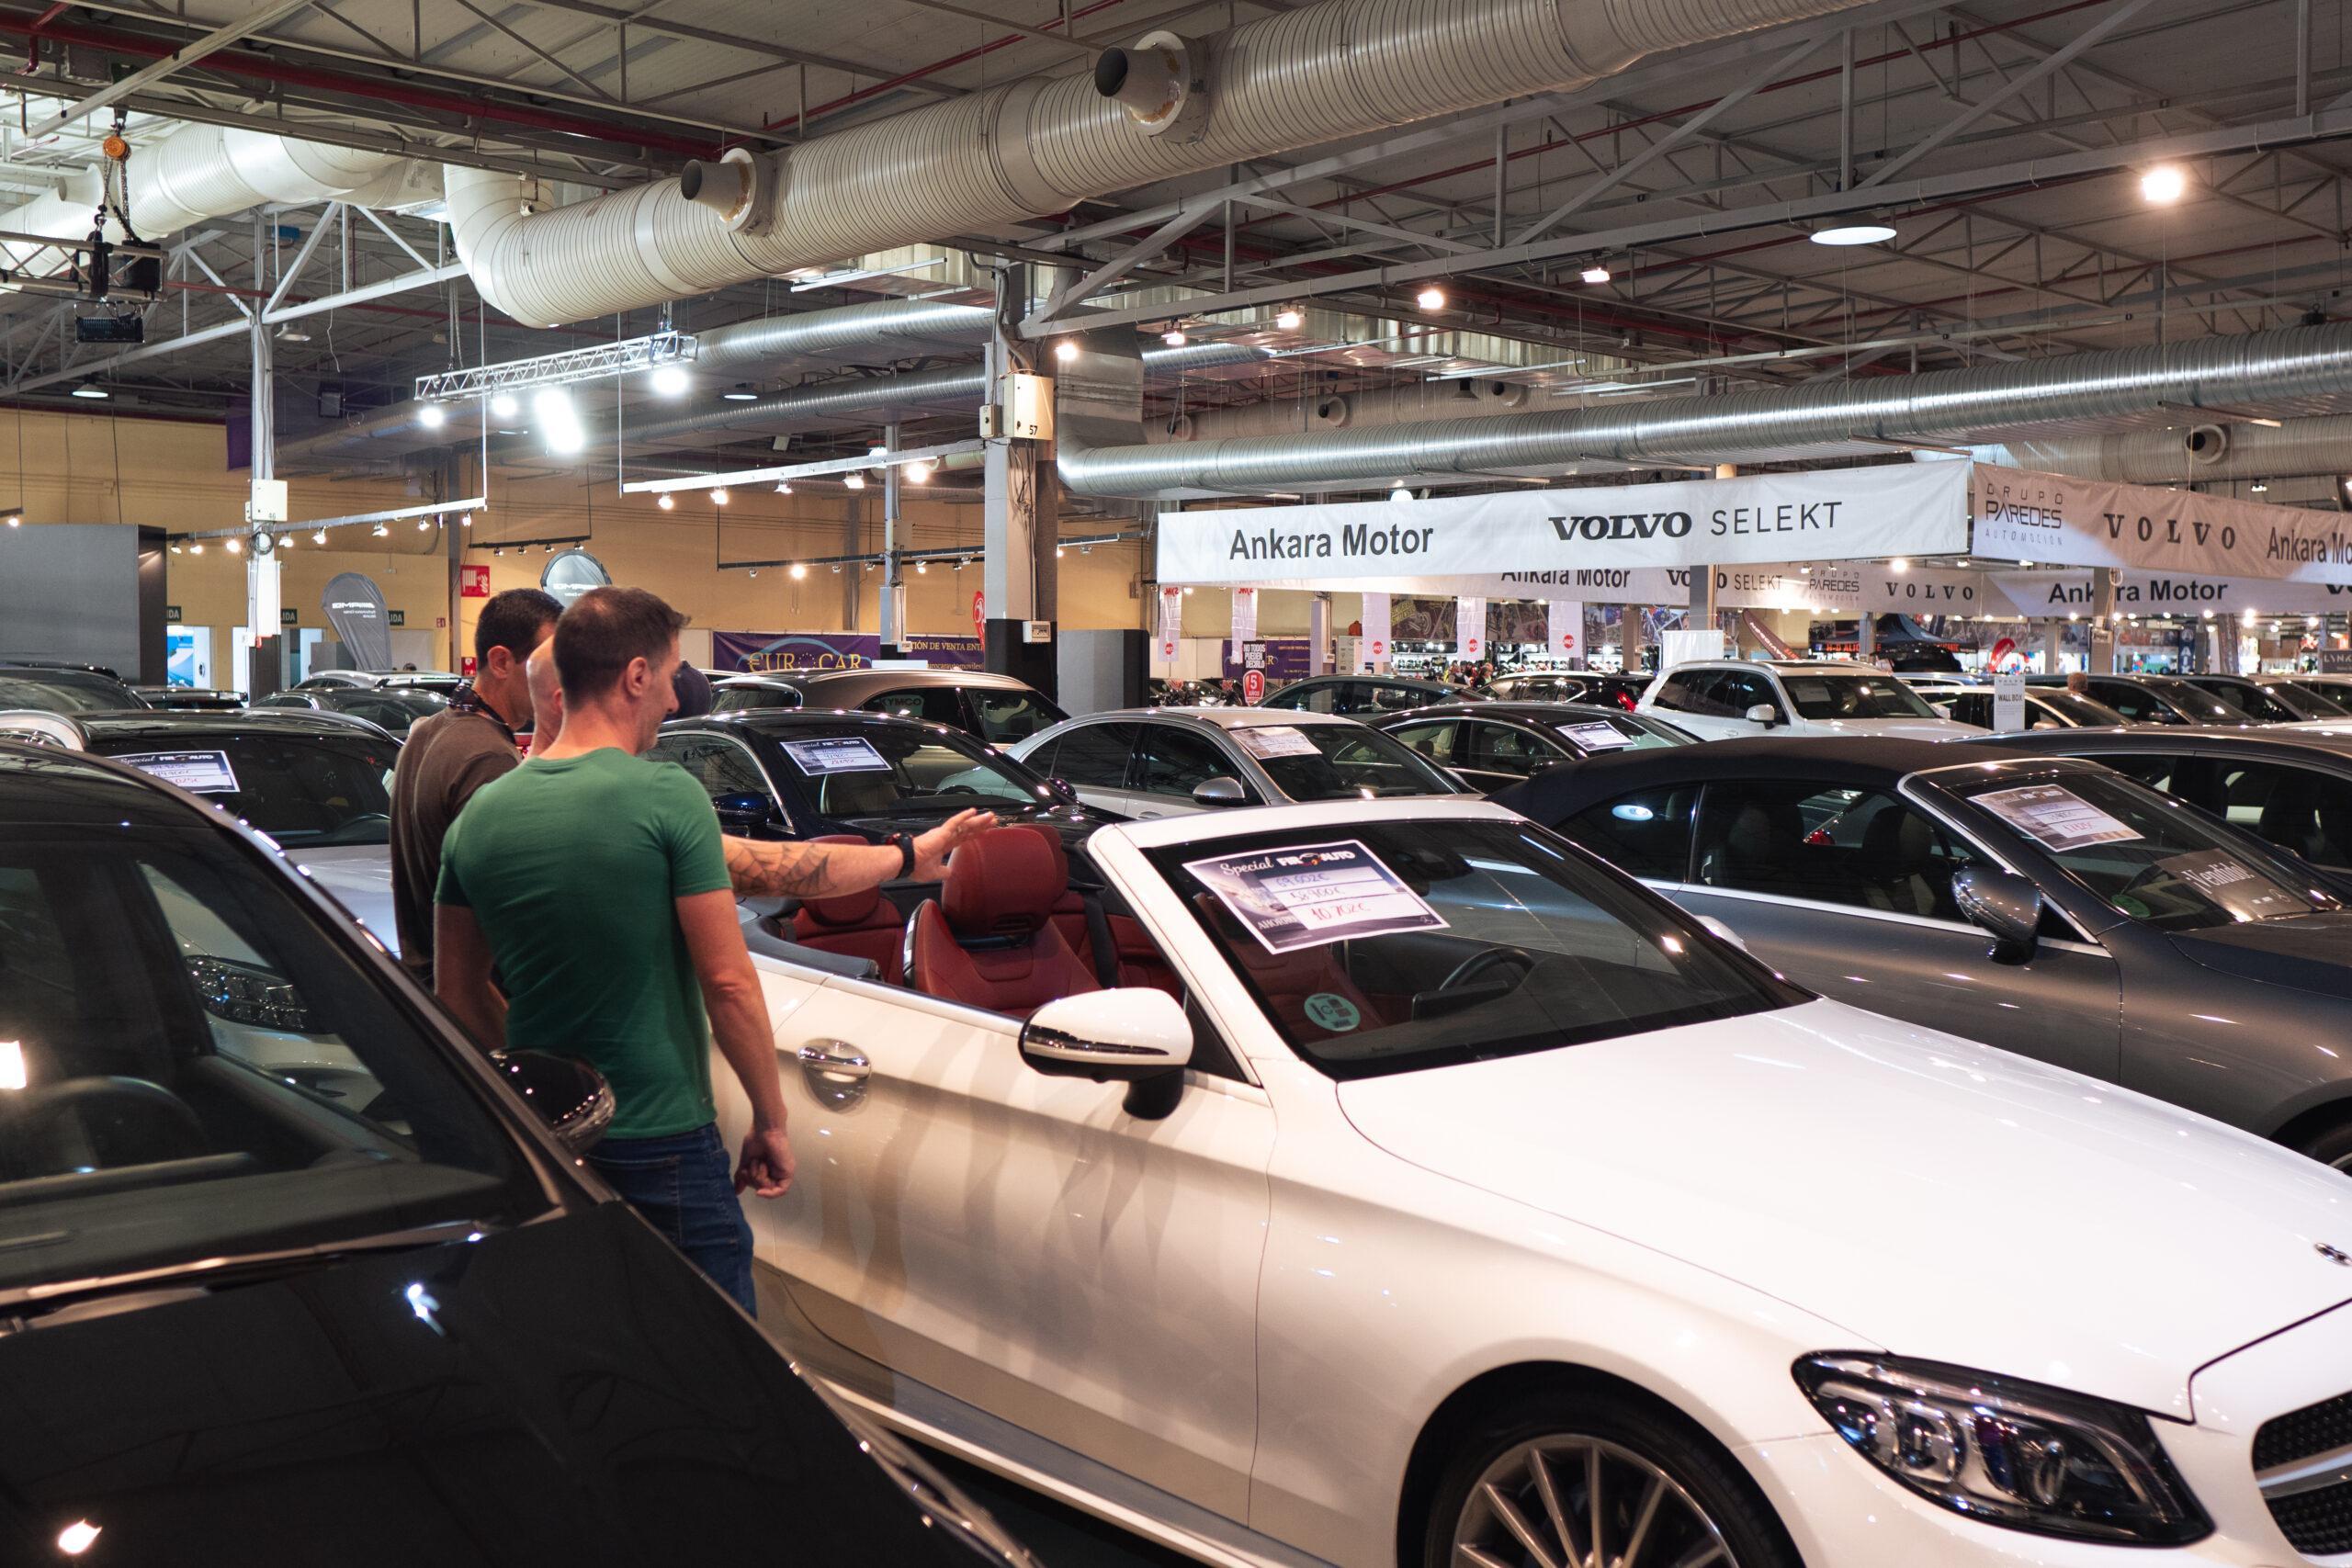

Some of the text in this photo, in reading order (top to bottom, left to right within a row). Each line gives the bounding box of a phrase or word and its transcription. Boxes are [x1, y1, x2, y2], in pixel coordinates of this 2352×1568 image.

[1029, 425, 1038, 435] 57
[1548, 502, 1842, 541] VOLVO SELEKT
[1985, 501, 2062, 529] PAREDES
[2103, 513, 2236, 550] VOLVO
[1229, 524, 1434, 560] Ankara Motor
[2267, 526, 2327, 563] Ankara
[1577, 569, 1631, 588] Motor
[1666, 569, 1783, 591] VOO SELEKT
[1809, 578, 1860, 592] PAREDES
[1885, 581, 1973, 601] VOLVO
[2048, 580, 2229, 604] Ankra Motor
[941, 642, 966, 651] VENTA
[1250, 674, 1258, 690] 5
[1997, 694, 2023, 702] WALL BOX
[1220, 856, 1274, 876] Special
